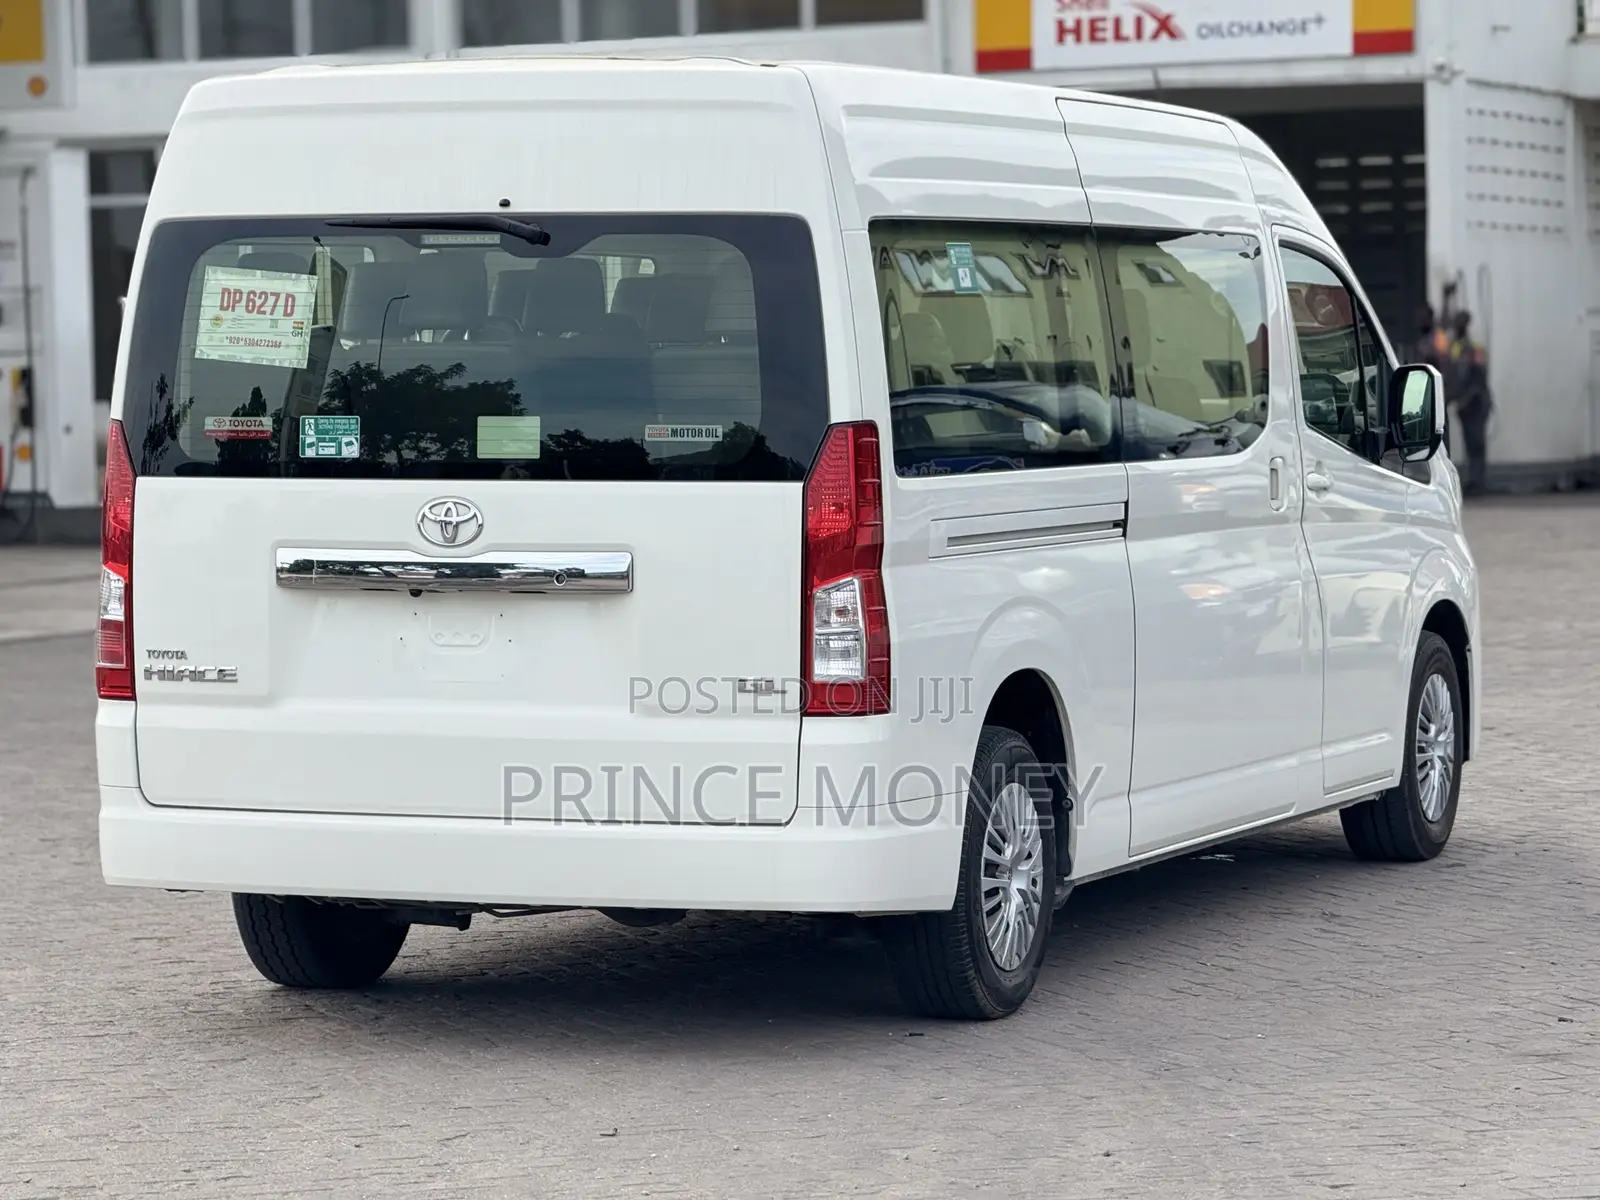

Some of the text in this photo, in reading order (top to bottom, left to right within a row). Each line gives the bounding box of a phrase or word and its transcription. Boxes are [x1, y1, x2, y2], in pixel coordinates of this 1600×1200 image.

[1056, 13, 1181, 45] HELIX
[219, 287, 297, 318] DP 627 D
[291, 330, 303, 338] GH
[228, 419, 265, 428] TOYOTA
[670, 427, 704, 438] MOTOR
[704, 427, 720, 438] OIL
[146, 649, 188, 660] TOYOTA
[143, 663, 238, 683] HIACE
